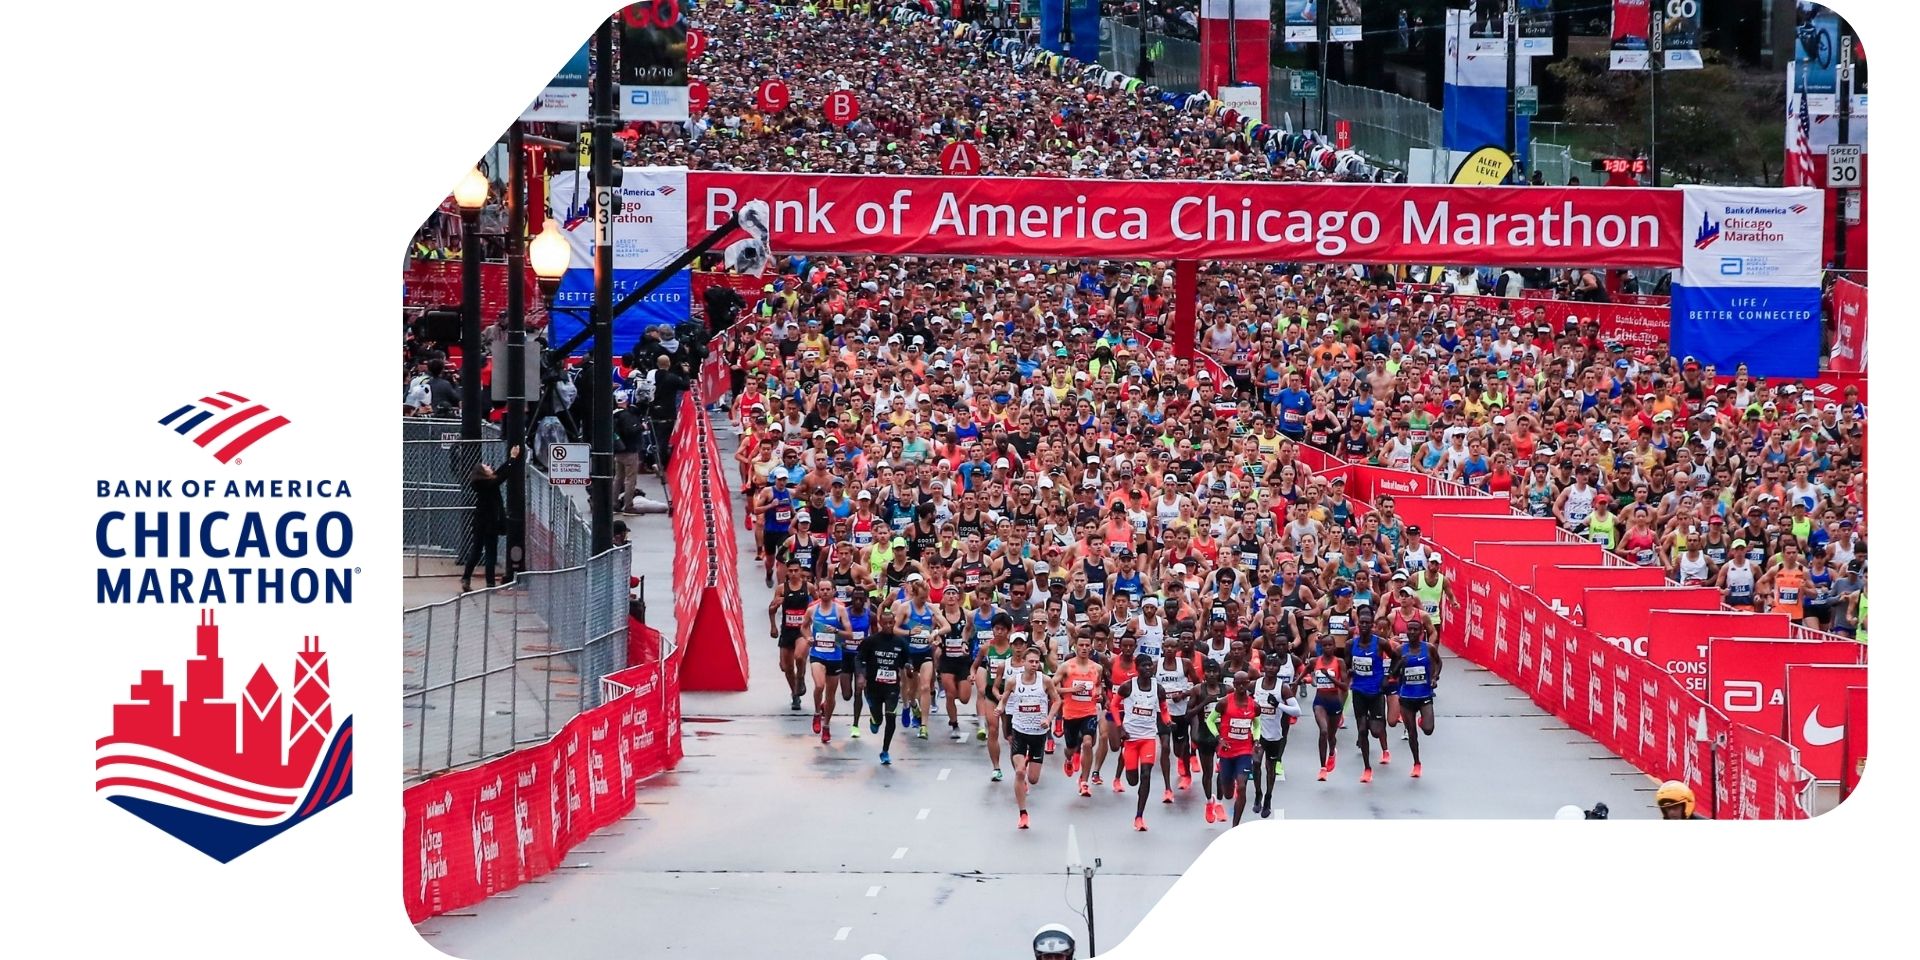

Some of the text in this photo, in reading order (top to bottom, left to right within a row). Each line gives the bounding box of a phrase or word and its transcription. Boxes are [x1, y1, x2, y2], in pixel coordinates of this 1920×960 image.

[623, 0, 679, 28] GO
[1667, 0, 1697, 18] GO
[688, 82, 700, 103] C
[765, 83, 779, 103] C
[834, 94, 851, 115] B
[949, 144, 971, 170] A
[1478, 156, 1503, 169] ALERT
[1833, 156, 1855, 164] LIMIT
[1475, 165, 1500, 179] LEVEL
[1832, 166, 1857, 181] 30
[623, 188, 655, 196] America
[1725, 206, 1745, 214] Bank
[1754, 207, 1787, 215] America
[612, 213, 653, 223] rathon
[706, 187, 1659, 256] Bnk of America Chicago Marathon
[1724, 218, 1773, 231] Chicago
[1724, 231, 1784, 241] Marathon
[559, 292, 596, 301] BETTE
[1731, 298, 1759, 307] LIFE
[1615, 315, 1633, 325] Bank
[1634, 316, 1643, 325] of
[1689, 310, 1811, 320] BETTER CONNECTED
[1614, 328, 1659, 346] Chicago
[1666, 660, 1707, 675] CONS
[1686, 677, 1707, 690] SEI
[1768, 692, 1785, 706] A
